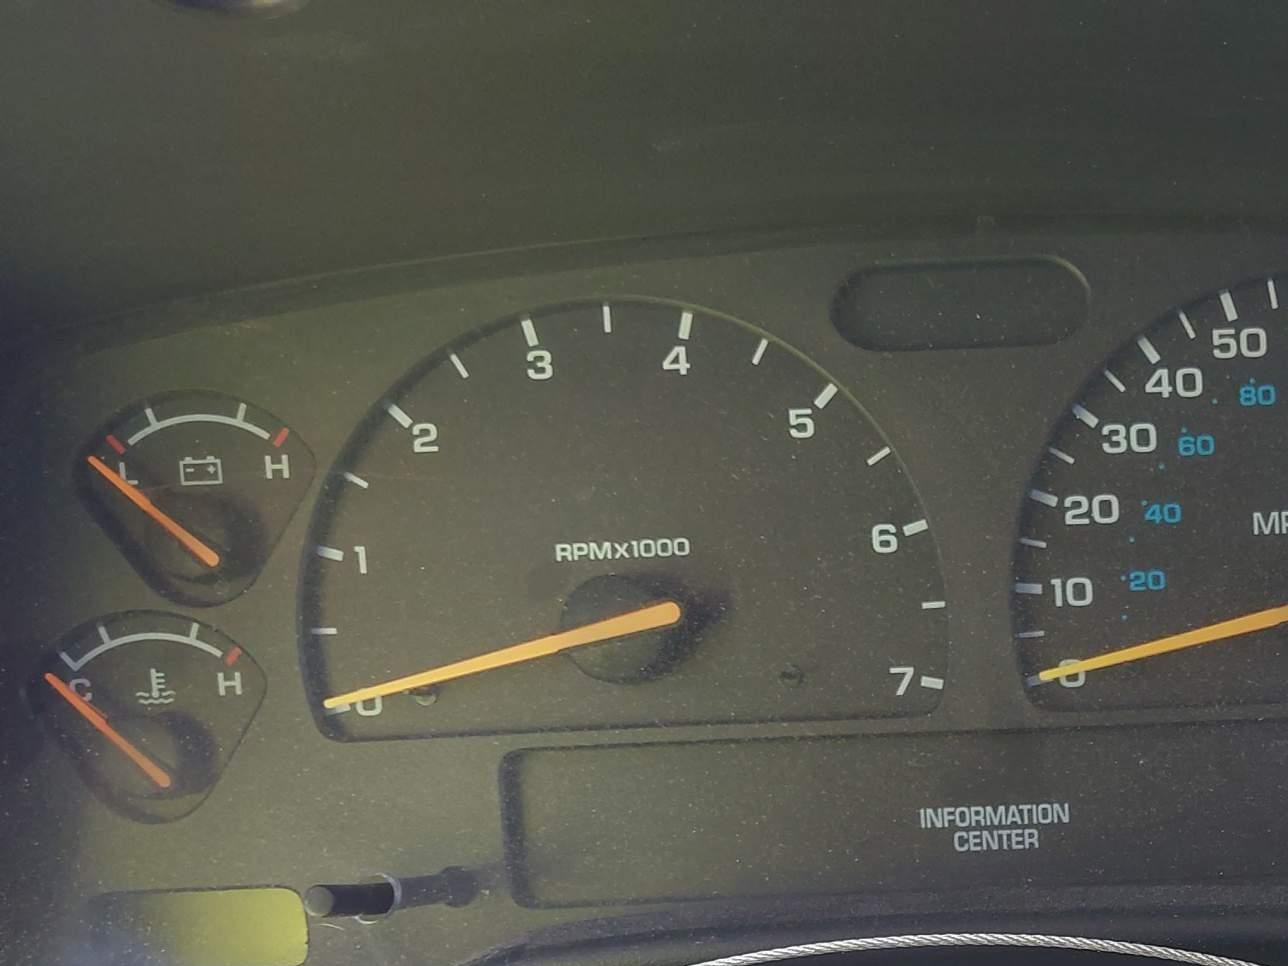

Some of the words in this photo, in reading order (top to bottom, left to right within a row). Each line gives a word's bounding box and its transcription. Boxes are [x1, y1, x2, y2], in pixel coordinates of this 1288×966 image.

[1213, 328, 1266, 358] 50
[527, 351, 552, 379] 3
[663, 346, 690, 374] 4
[1146, 368, 1202, 397] 40
[1240, 385, 1275, 406] 80
[789, 409, 814, 438] 5
[413, 424, 438, 452] 2
[1102, 424, 1156, 453] 30
[1178, 436, 1214, 456] 60
[265, 454, 290, 479] H
[1064, 495, 1119, 525] 20
[1145, 504, 1181, 523] 40
[872, 524, 897, 553] 6
[354, 546, 367, 573] 1
[1051, 578, 1093, 607] 10
[1129, 570, 1166, 591] 20
[217, 671, 242, 696] H
[890, 667, 914, 695] 7
[1059, 659, 1086, 688] 0
[919, 803, 1070, 828] INFORMATION
[953, 828, 1039, 852] CENTER
